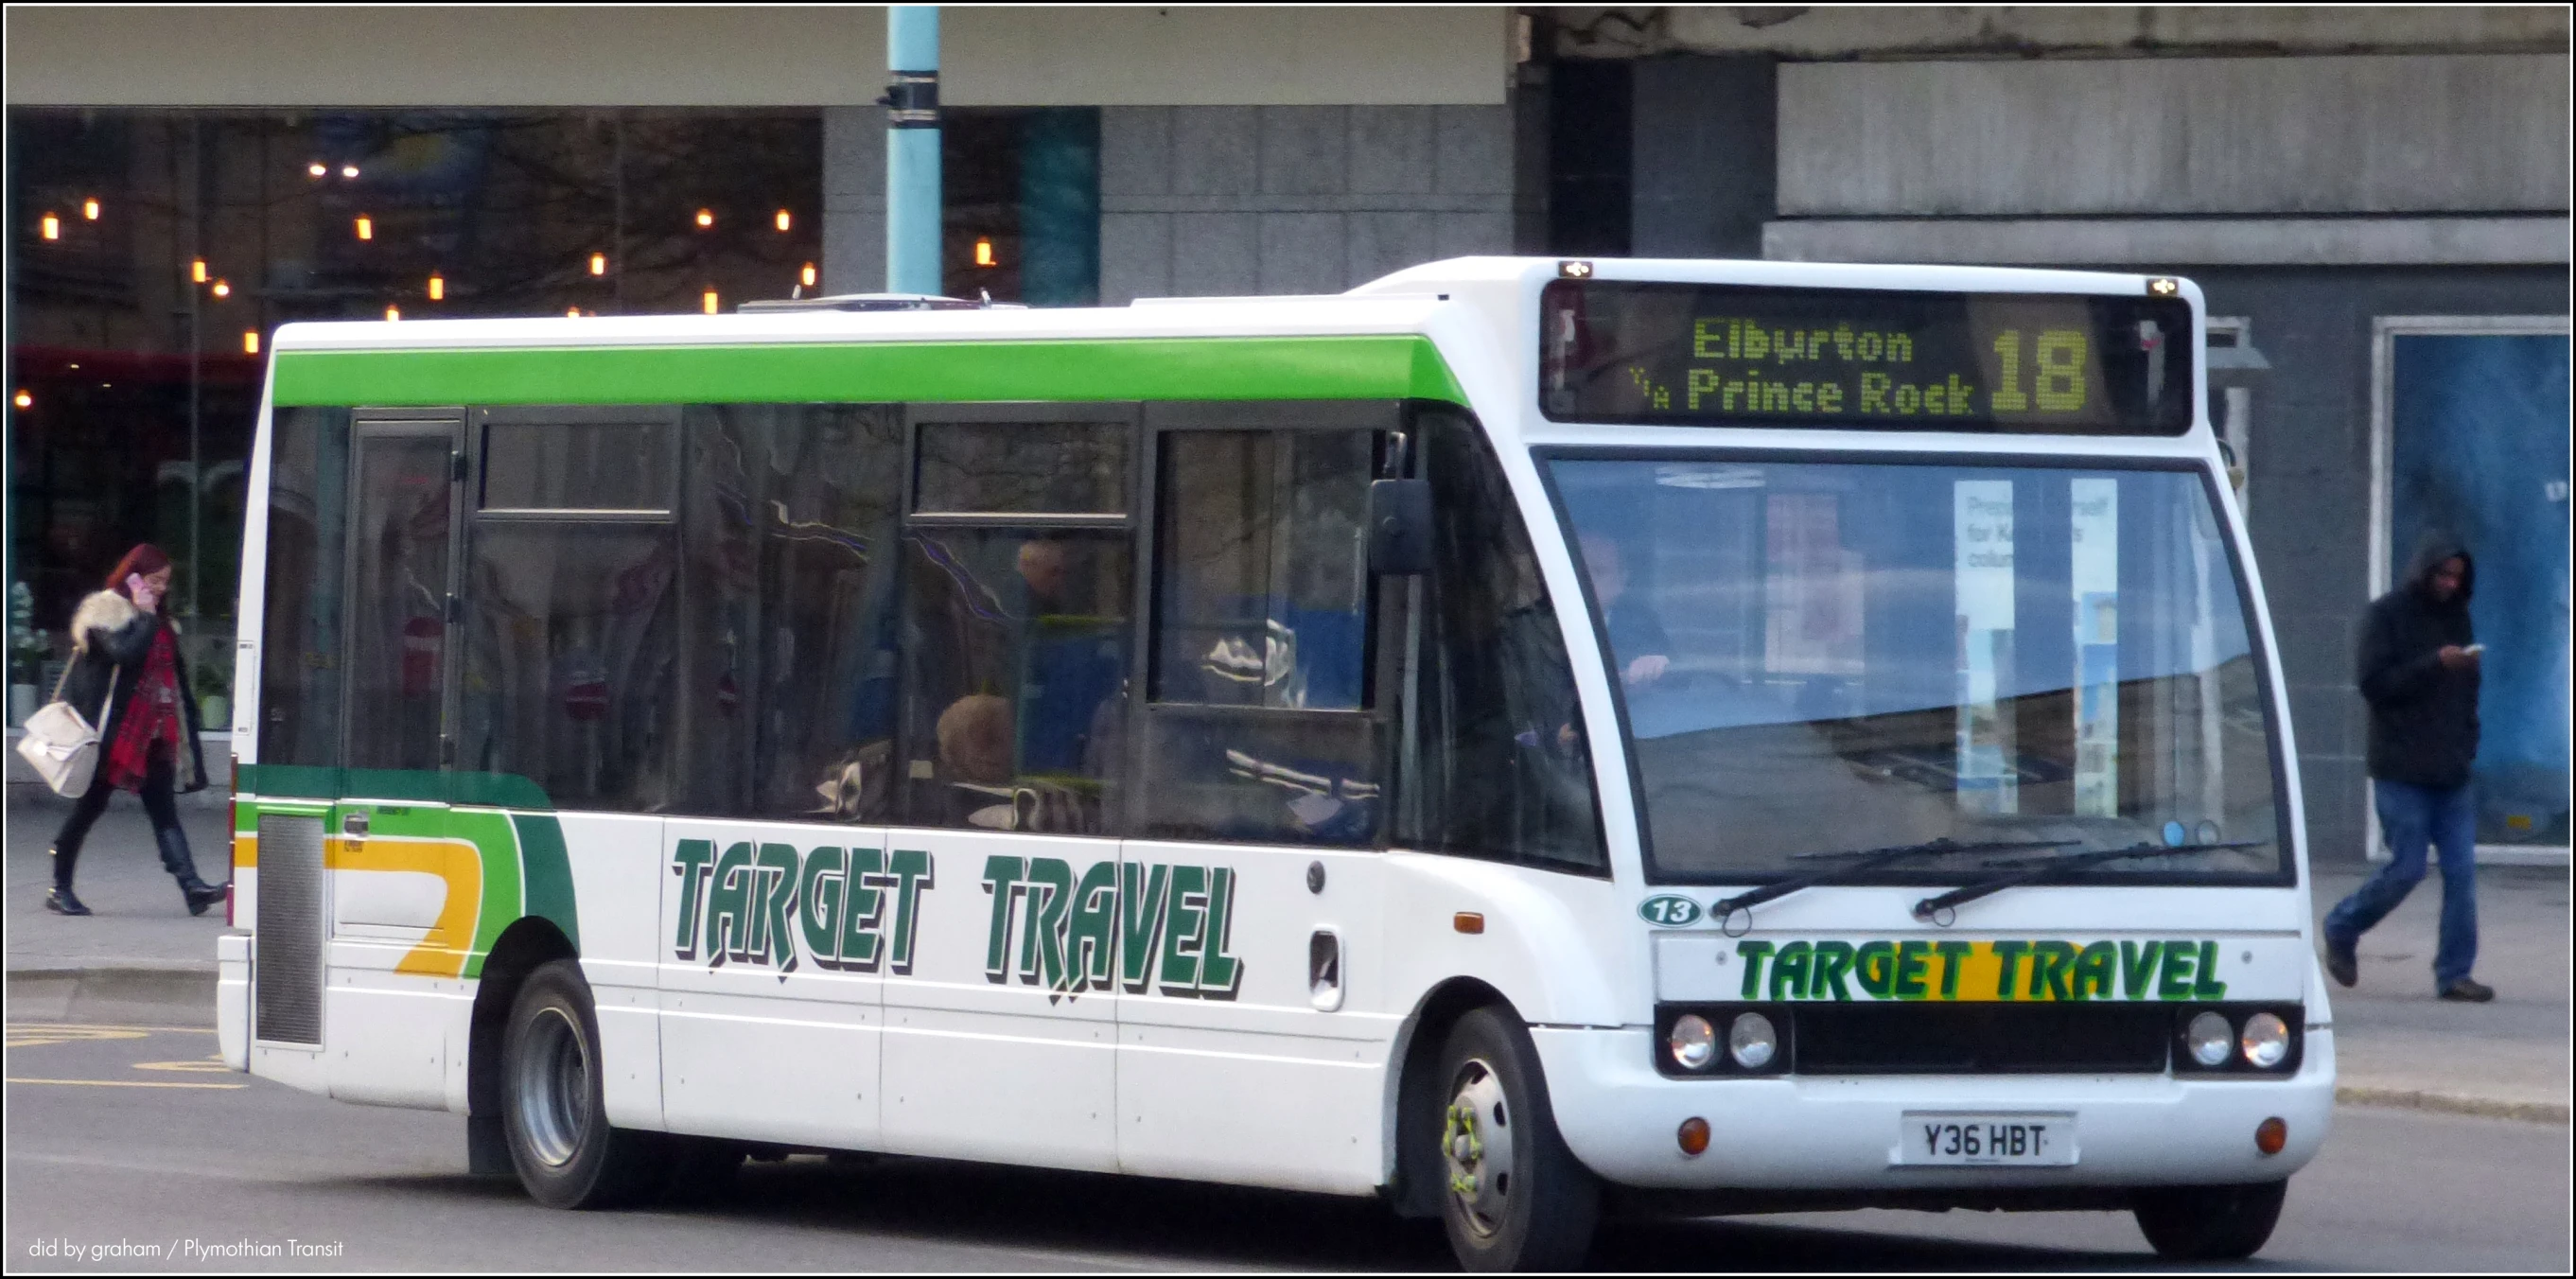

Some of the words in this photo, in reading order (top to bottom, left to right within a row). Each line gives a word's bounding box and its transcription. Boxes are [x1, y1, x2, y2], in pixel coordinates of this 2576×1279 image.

[1693, 318, 1913, 364] Elburton
[1688, 368, 1844, 413] Prince
[1860, 371, 1975, 416] Rock
[1991, 329, 2089, 412] 18
[673, 838, 935, 984] TARGET
[981, 854, 1245, 1007] TRAVEL
[1653, 901, 1692, 922] 13
[1736, 939, 1973, 1004] TARGET
[1991, 939, 2229, 1004] TRAVEL
[1924, 1124, 1981, 1156] Y36
[1989, 1125, 2046, 1156] HBT
